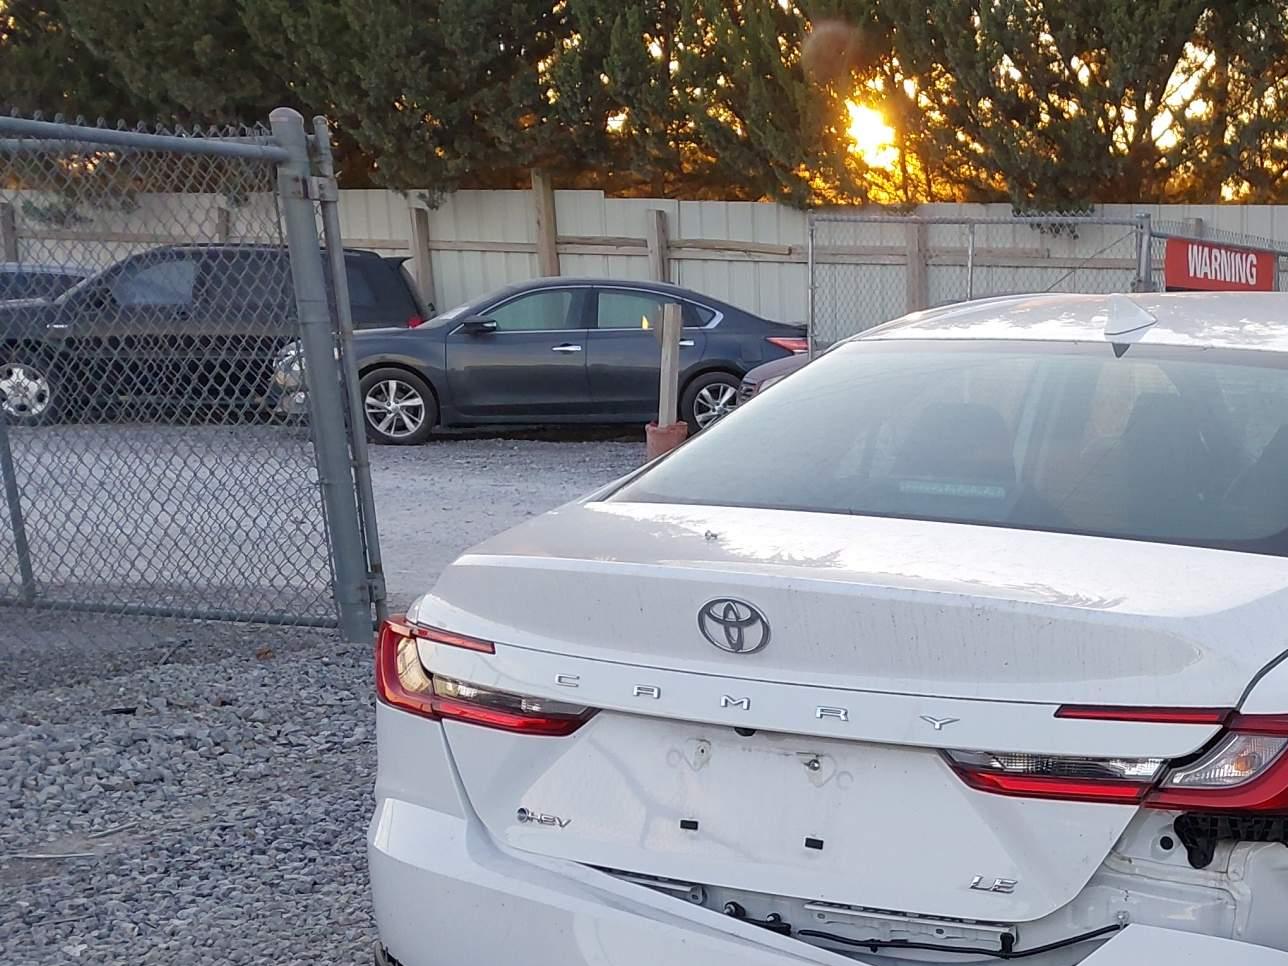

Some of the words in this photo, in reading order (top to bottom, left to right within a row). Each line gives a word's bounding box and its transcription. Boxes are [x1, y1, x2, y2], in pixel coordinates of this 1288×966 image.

[1188, 243, 1257, 285] WARNING
[556, 674, 960, 730] CAMRY
[968, 874, 1018, 894] LE
